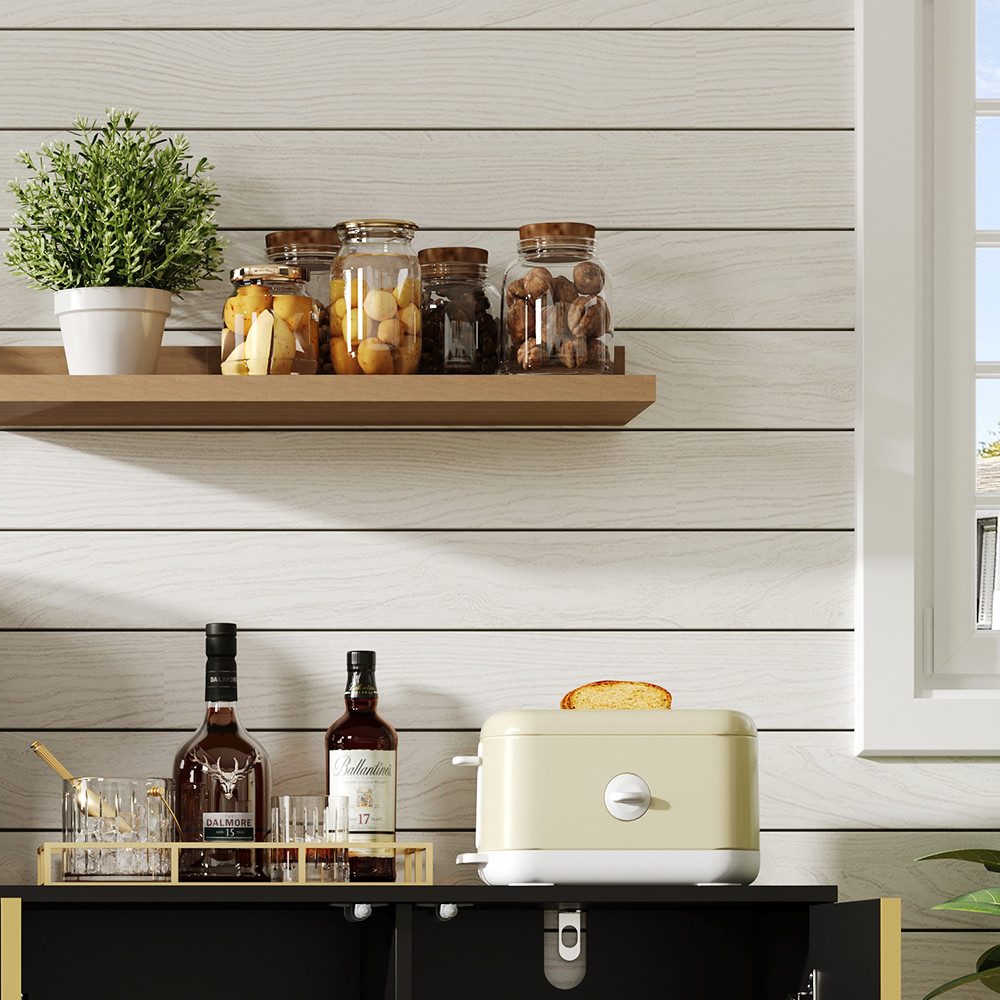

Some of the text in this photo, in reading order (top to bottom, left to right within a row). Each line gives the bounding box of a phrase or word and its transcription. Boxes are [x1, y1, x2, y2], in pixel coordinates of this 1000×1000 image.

[334, 756, 392, 776] Ballantine's
[206, 819, 253, 827] DALMORE
[358, 813, 371, 825] 17
[225, 828, 235, 837] 15
